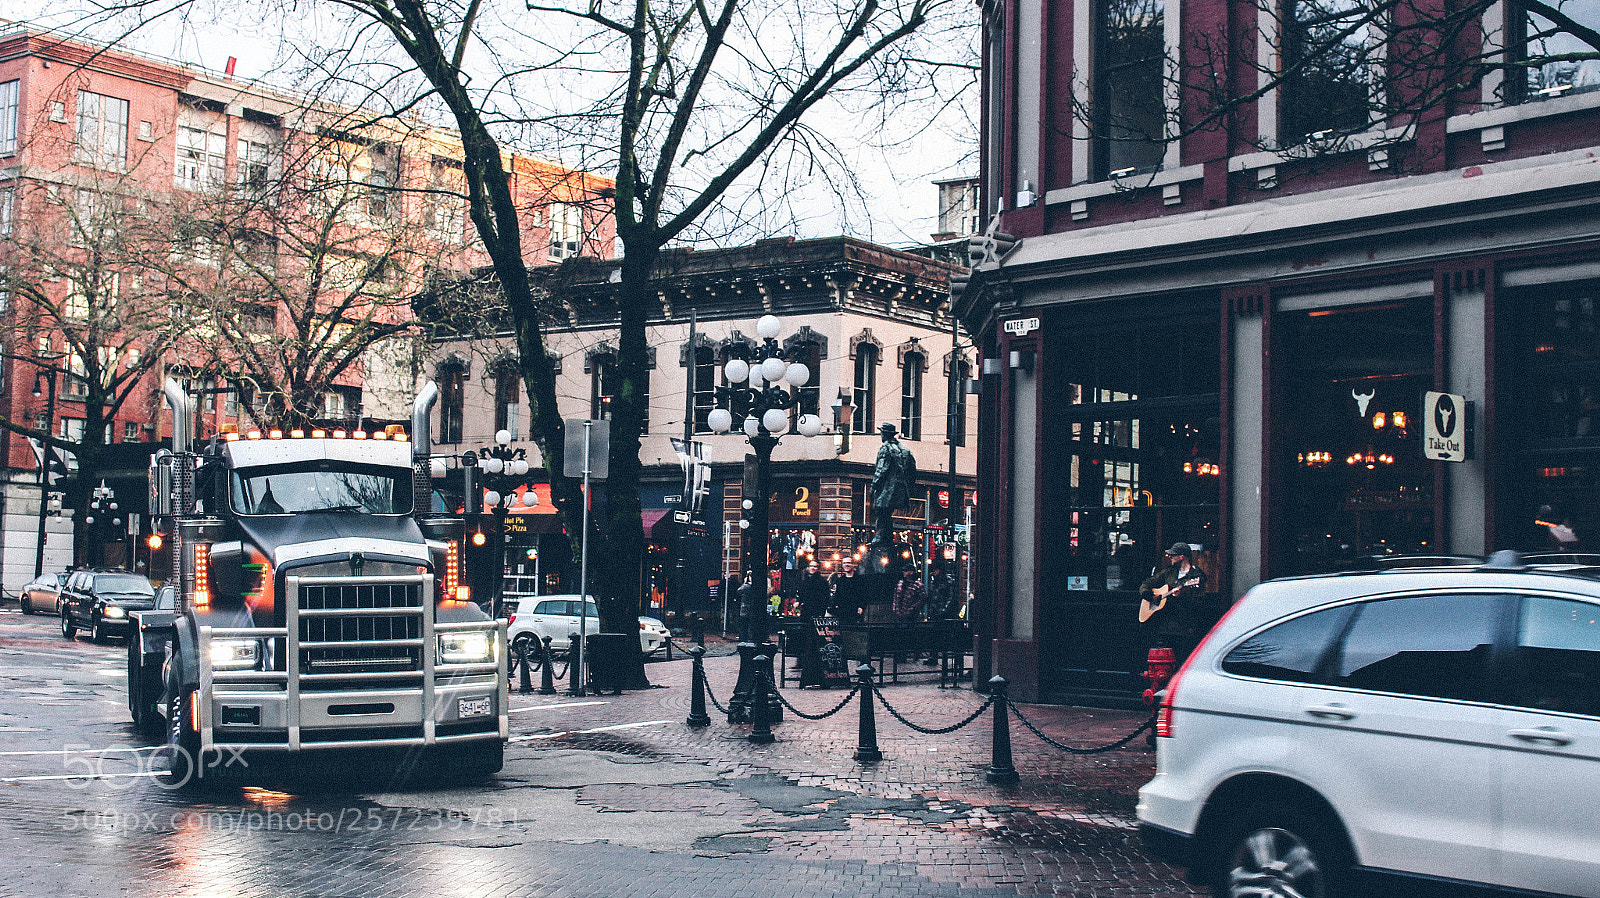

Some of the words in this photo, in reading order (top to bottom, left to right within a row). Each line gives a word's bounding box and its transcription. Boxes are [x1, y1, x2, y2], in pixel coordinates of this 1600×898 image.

[1006, 321, 1024, 331] WATER
[1428, 437, 1446, 450] Take
[1446, 439, 1460, 452] Out
[794, 486, 809, 509] 2
[515, 516, 525, 524] Pie
[512, 524, 527, 532] Pizza
